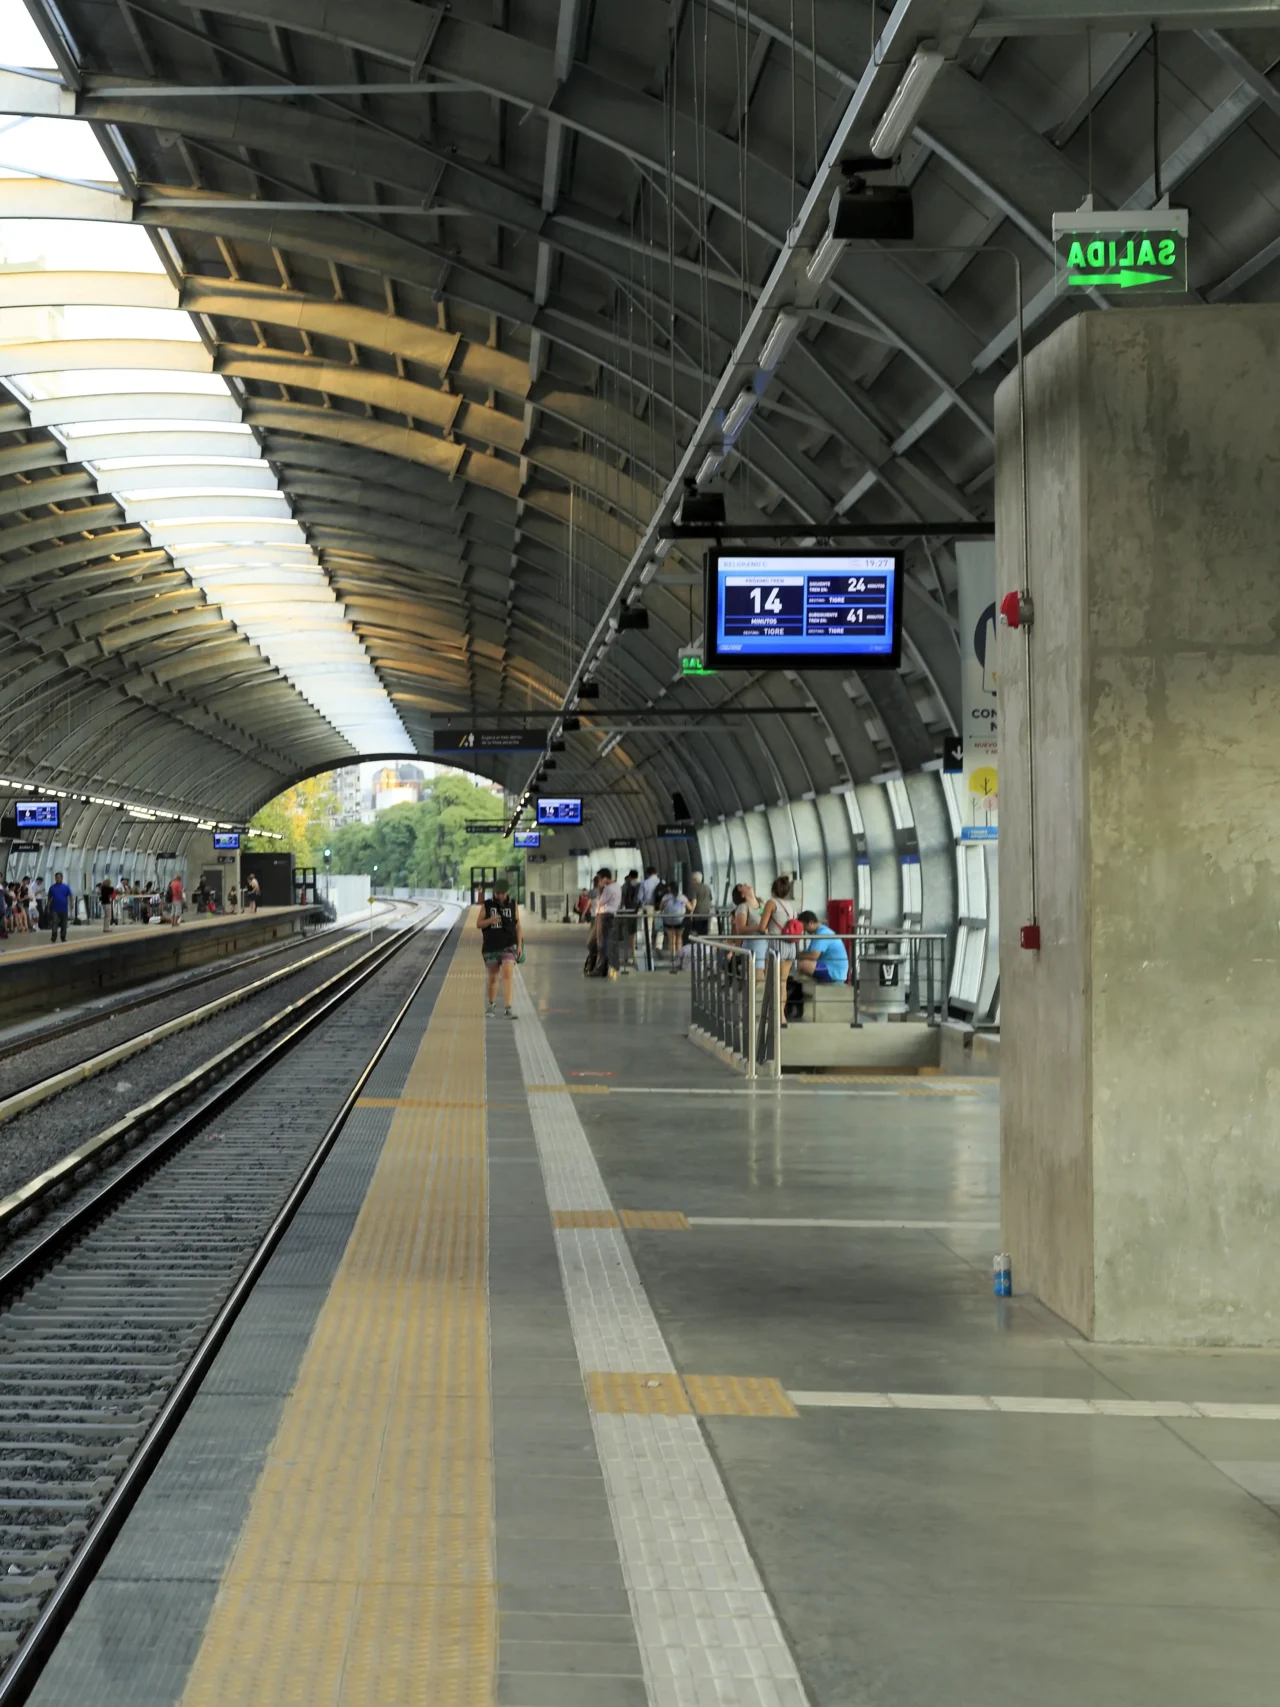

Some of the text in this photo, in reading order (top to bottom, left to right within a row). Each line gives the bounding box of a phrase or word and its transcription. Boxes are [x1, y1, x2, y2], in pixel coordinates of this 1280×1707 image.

[865, 560, 888, 568] 19:27
[847, 577, 866, 592] 24
[750, 587, 782, 613] 14
[846, 608, 863, 623] 41
[764, 627, 784, 635] TIGRE
